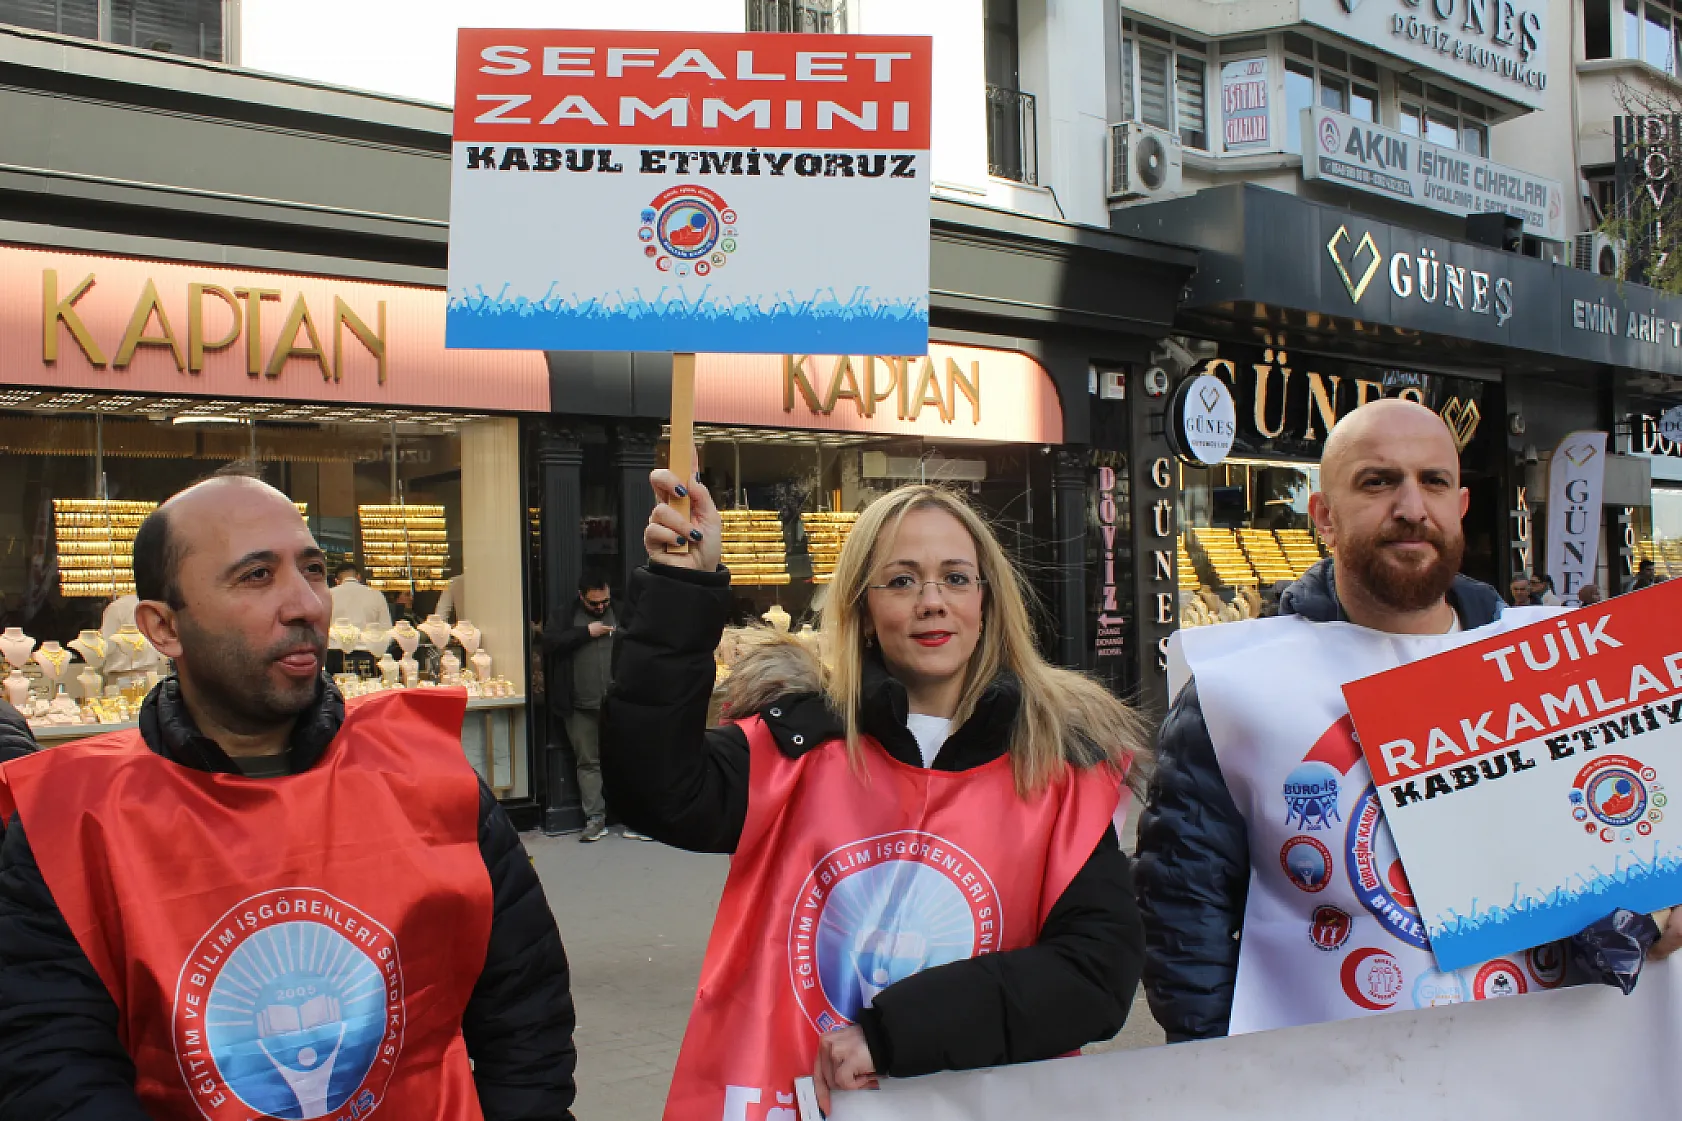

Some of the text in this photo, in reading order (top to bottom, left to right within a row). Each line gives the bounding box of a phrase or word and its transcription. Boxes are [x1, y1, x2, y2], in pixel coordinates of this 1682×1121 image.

[479, 45, 912, 83] SEFALET
[1392, 13, 1450, 53] DÖVİZ
[1467, 43, 1548, 91] KUYUMCU
[474, 94, 910, 132] ZAMMINI
[466, 146, 916, 179] KABUL ETMİYORUZ
[1345, 126, 1408, 171] AKIN
[1474, 165, 1547, 209] CİHAZLARI
[1388, 248, 1513, 328] GÜNEŞ
[1573, 297, 1618, 336] EMİN
[1626, 309, 1666, 344] ARİF
[43, 268, 388, 386] KAPTAN
[783, 354, 980, 424] KAPTAN
[1186, 415, 1234, 438] GÜNEŞ
[1098, 466, 1118, 610] DÖVİZ
[1563, 479, 1590, 606] GÜNE
[1482, 614, 1624, 682] TUİK
[1390, 749, 1537, 808] KABUL
[820, 849, 871, 885] BİLİM
[876, 840, 991, 903] İŞGÖRENLERİ
[1354, 804, 1378, 891] BİRLEŞİK KAMU
[804, 885, 824, 910] VE
[794, 916, 815, 990] EĞİTİM
[183, 896, 400, 1109] EĞİTİM VE BİLİM İŞGÖRENLERİ SENDİKASI
